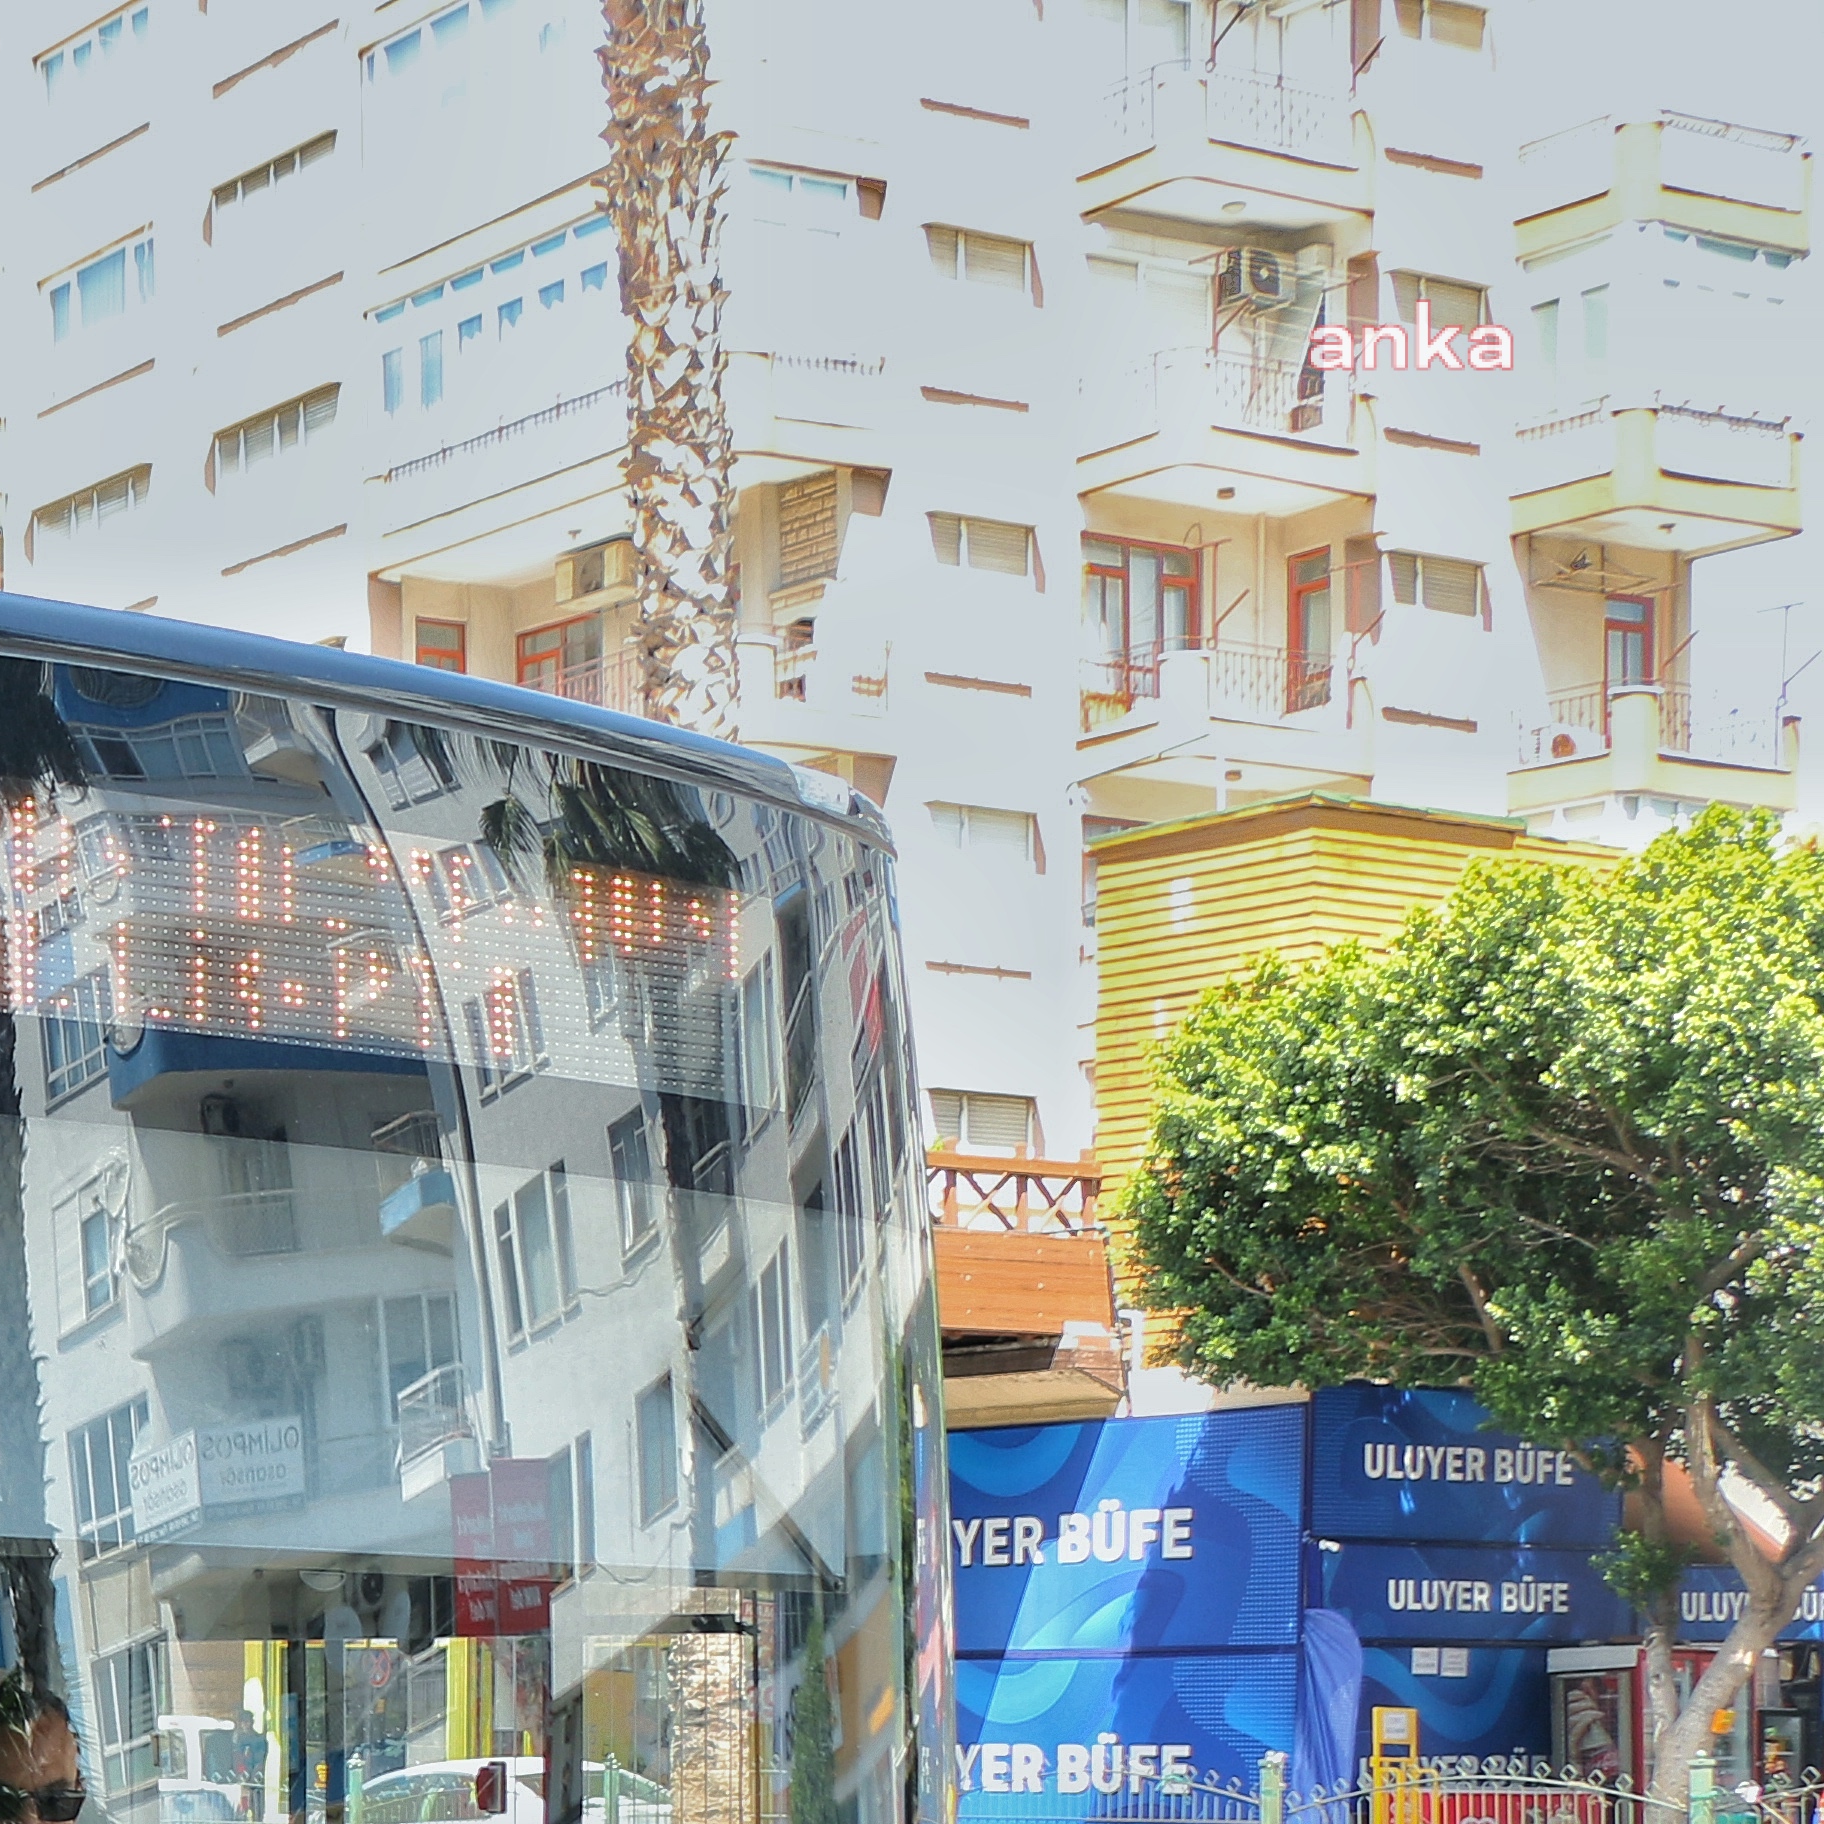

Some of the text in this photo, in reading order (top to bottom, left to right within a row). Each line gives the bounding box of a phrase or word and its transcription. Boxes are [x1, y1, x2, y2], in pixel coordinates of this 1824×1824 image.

[1363, 1441, 1575, 1485] ULUYER BÜFE
[1057, 1498, 1193, 1565] BÜFE
[1388, 1575, 1570, 1614] ULUYER BÜFE
[1680, 1591, 1750, 1621] ULUY
[1056, 1732, 1192, 1795] BÜFE
